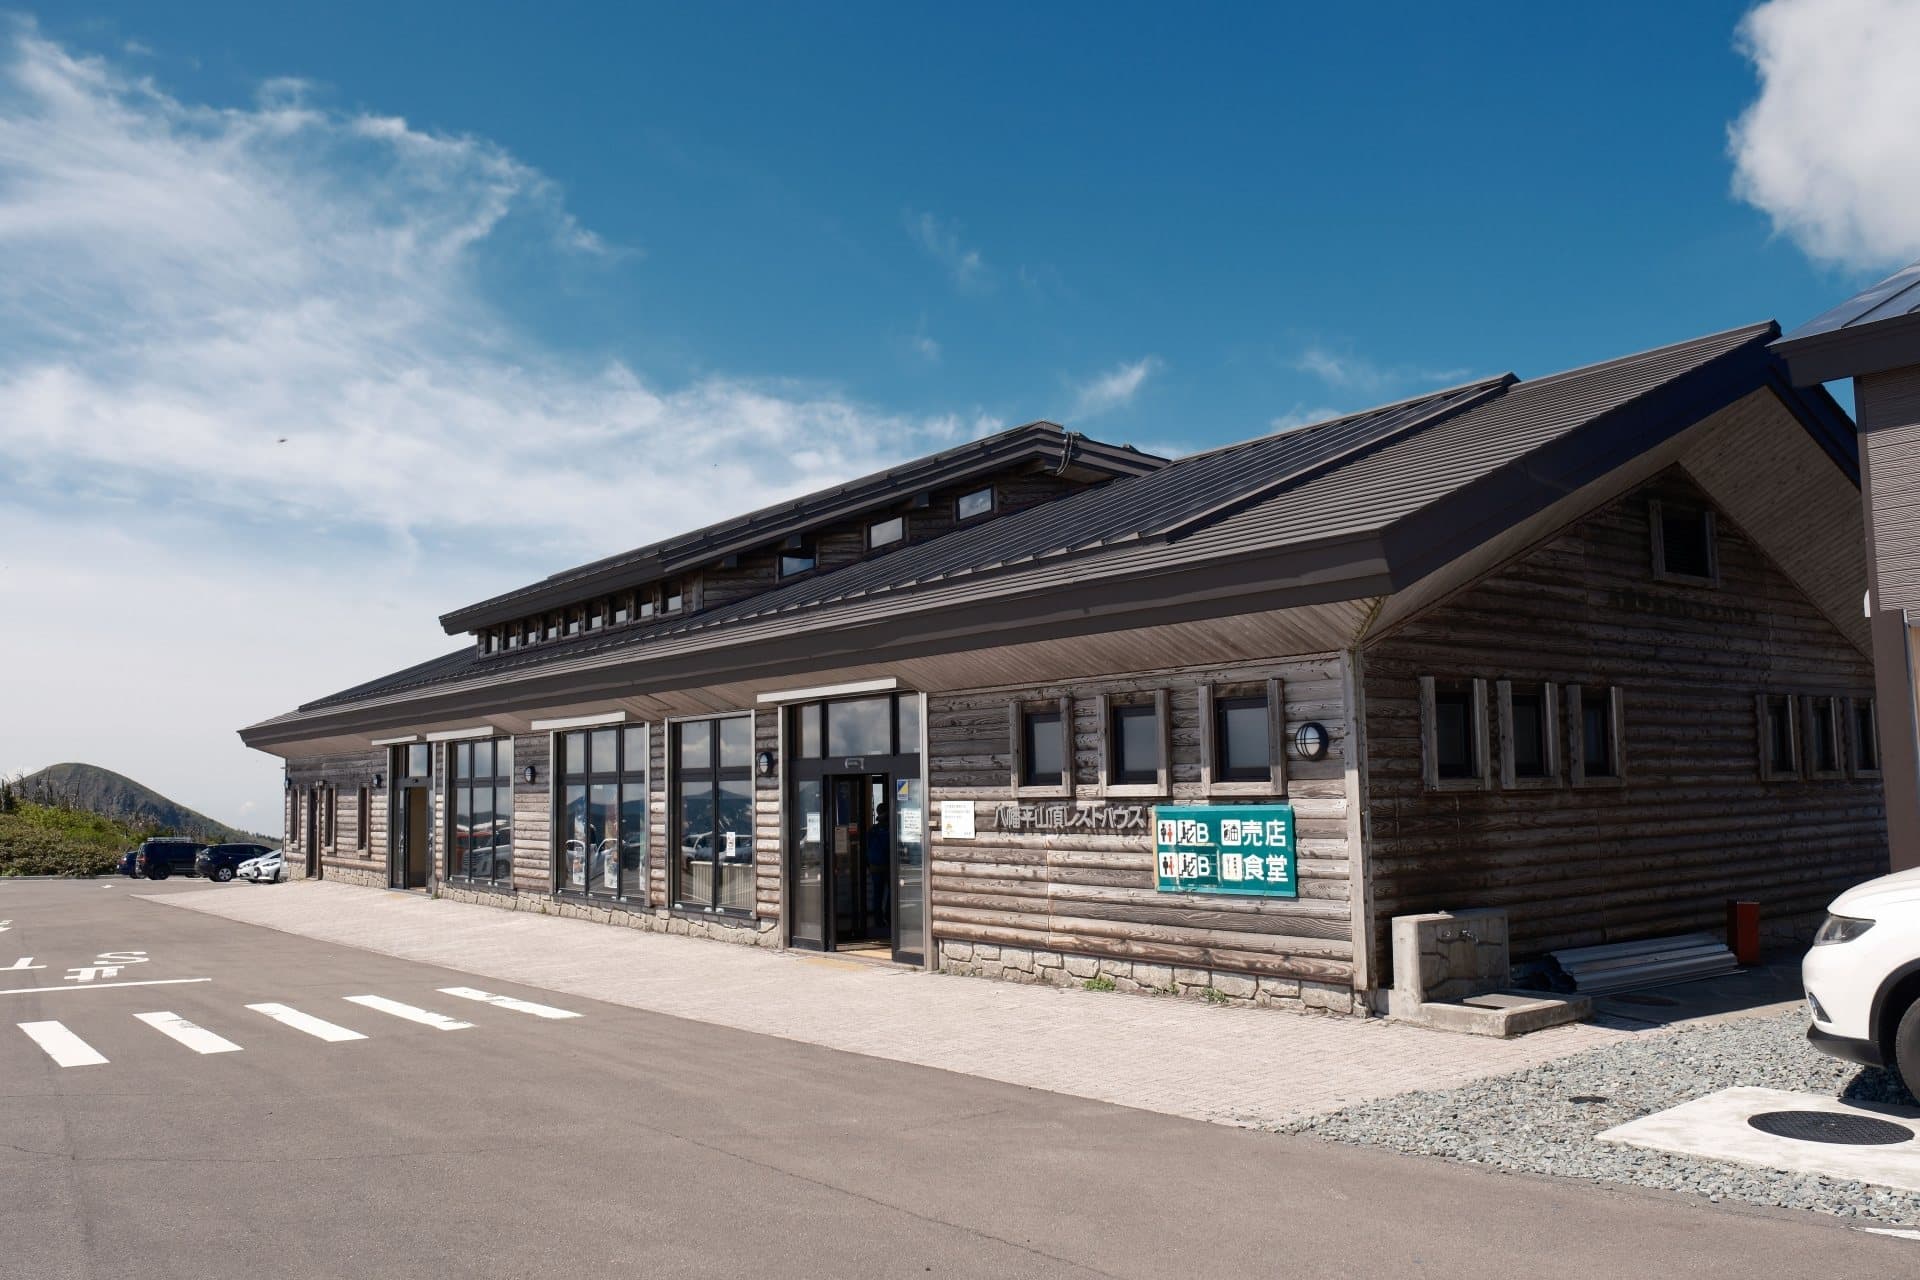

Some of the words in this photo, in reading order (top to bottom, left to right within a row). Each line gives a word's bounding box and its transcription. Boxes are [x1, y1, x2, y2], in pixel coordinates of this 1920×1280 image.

[993, 805, 1146, 829] 八幡平山頂レストハウス
[1197, 822, 1209, 843] B
[1241, 819, 1286, 847] 売店
[1198, 856, 1210, 877] B
[1243, 854, 1289, 882] 食堂
